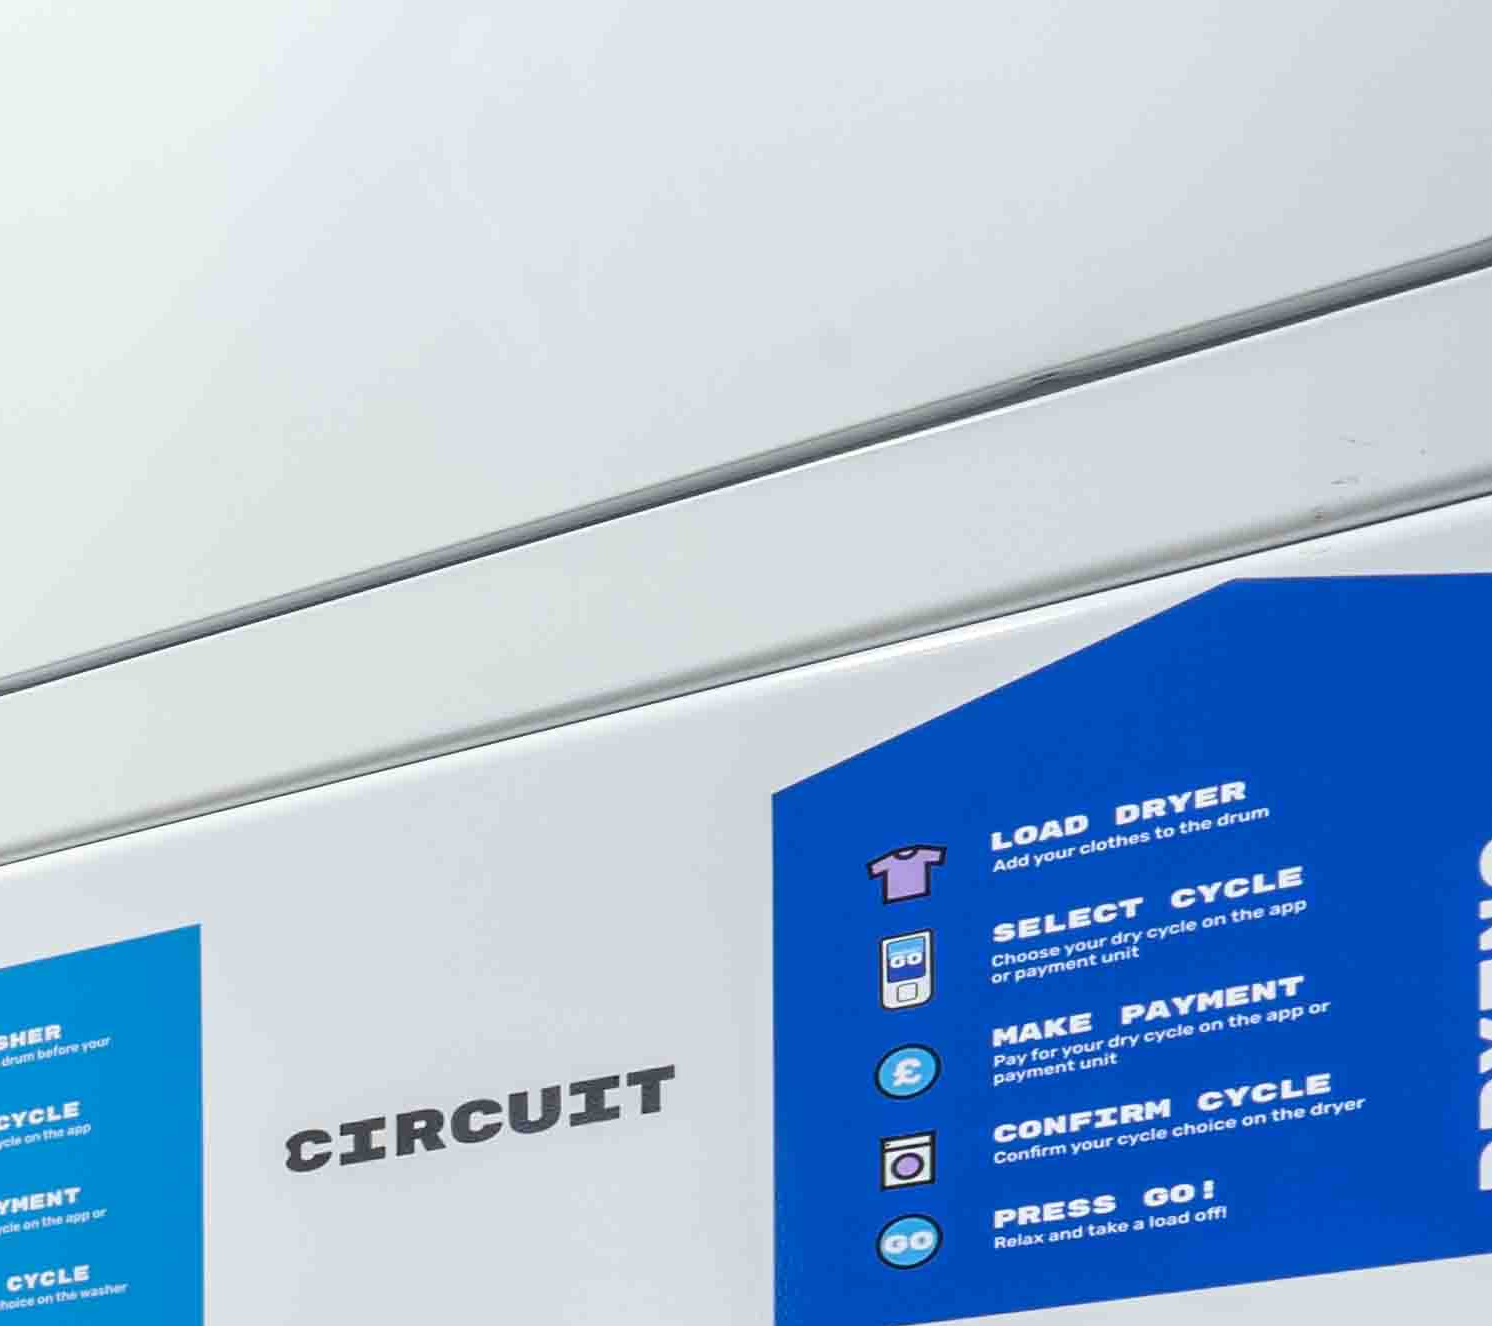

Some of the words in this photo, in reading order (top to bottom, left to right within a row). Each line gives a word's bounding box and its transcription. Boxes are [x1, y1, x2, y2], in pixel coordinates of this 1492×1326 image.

[991, 814, 1089, 852] LOAD
[1115, 781, 1246, 826] DRYER
[992, 853, 1030, 873] Add
[1033, 847, 1076, 867] your
[1079, 831, 1151, 855] clothes
[1154, 826, 1175, 840] to
[1178, 819, 1212, 834] the
[1216, 807, 1269, 827] drum
[991, 946, 1060, 968] Choose
[1064, 937, 1108, 957] your
[1110, 931, 1143, 946] dry
[1146, 919, 1197, 940] cycle
[1202, 915, 1227, 929] on
[1230, 907, 1265, 923] the
[1268, 899, 1307, 917] app
[993, 896, 1144, 943] SELECT
[1170, 865, 1303, 909] CYCLE
[992, 1012, 1092, 1048] MAKE
[1121, 975, 1304, 1025] PAYMENT
[285, 1064, 676, 1173] CIRCUIT
[993, 1098, 1171, 1143] CONFIRM
[1197, 1072, 1331, 1112] CYCLE
[994, 1144, 1067, 1165] Confirm
[1070, 1136, 1114, 1155] your
[1117, 1127, 1168, 1147] cycle
[1171, 1118, 1237, 1137] choice
[1241, 1113, 1267, 1127] on
[1271, 1107, 1306, 1122] the
[1309, 1098, 1366, 1116] dryer
[994, 1194, 1117, 1229] PRESS
[1143, 1180, 1214, 1207] GO!
[994, 1233, 1044, 1249] Relax
[1048, 1225, 1083, 1242] and
[1087, 1221, 1129, 1237] take
[1132, 1219, 1145, 1231] a
[1149, 1211, 1190, 1228] load
[1194, 1205, 1227, 1222] off!
[885, 1230, 935, 1254] GO
[6, 1264, 89, 1292] CYCLE
